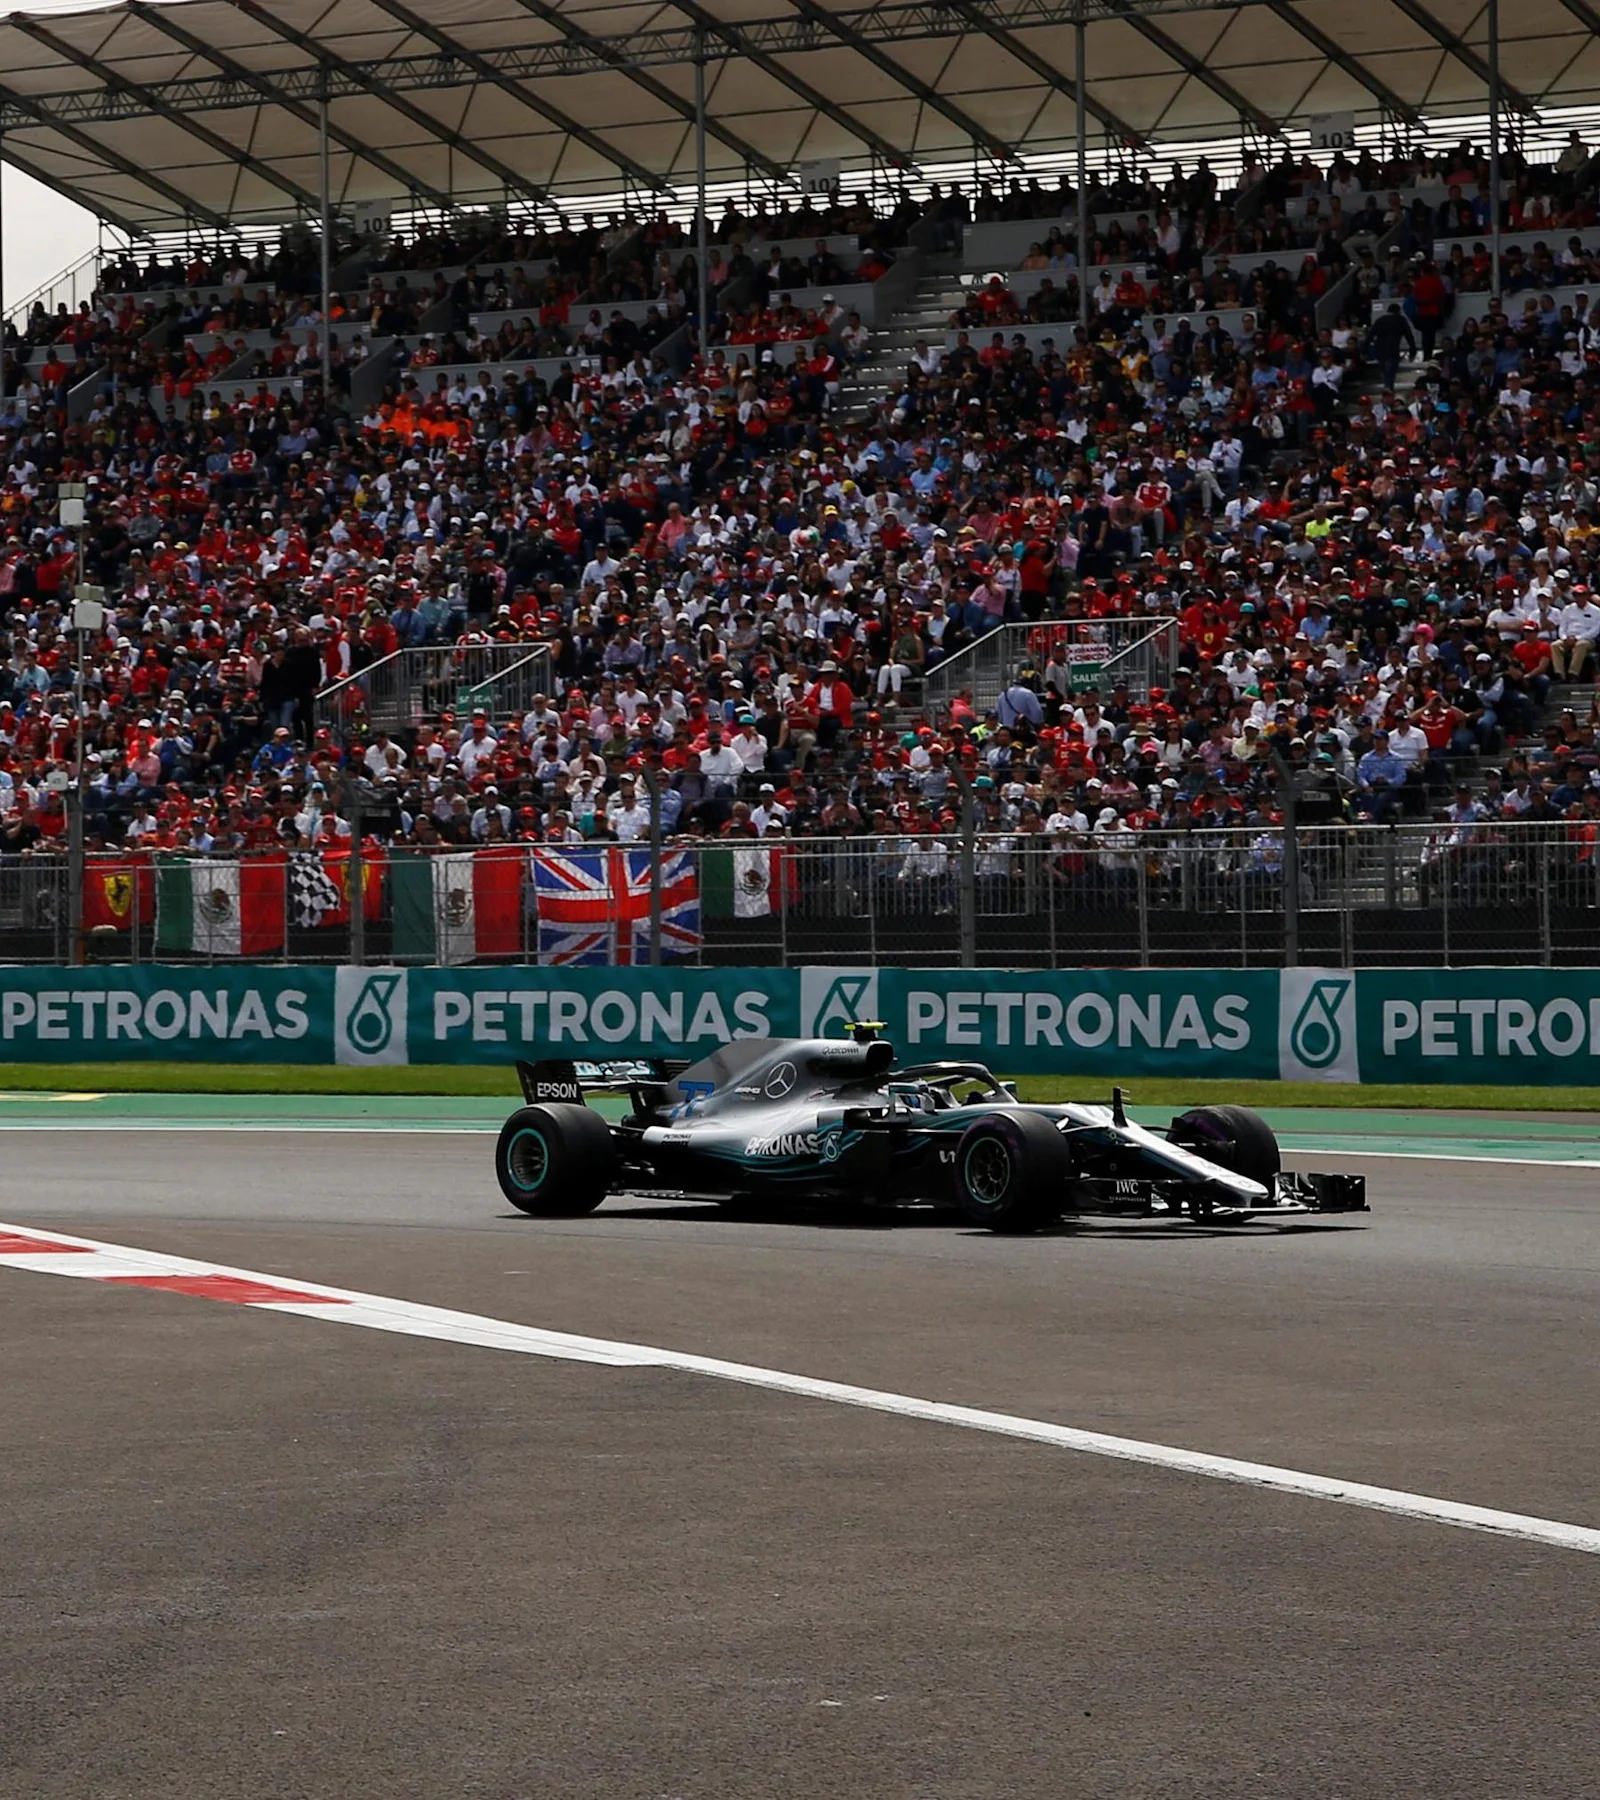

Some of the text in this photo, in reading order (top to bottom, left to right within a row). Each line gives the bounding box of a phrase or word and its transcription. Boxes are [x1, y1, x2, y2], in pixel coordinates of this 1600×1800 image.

[1319, 132, 1353, 148] 103
[2, 989, 309, 1040] PETRONAS
[433, 990, 771, 1042] PETRONAS
[907, 991, 1251, 1050] PETRONAS
[1382, 997, 1600, 1057] PETRO
[536, 1082, 578, 1099] EPSON
[744, 1133, 819, 1156] PETRONAS
[1116, 1180, 1139, 1195] IWC
